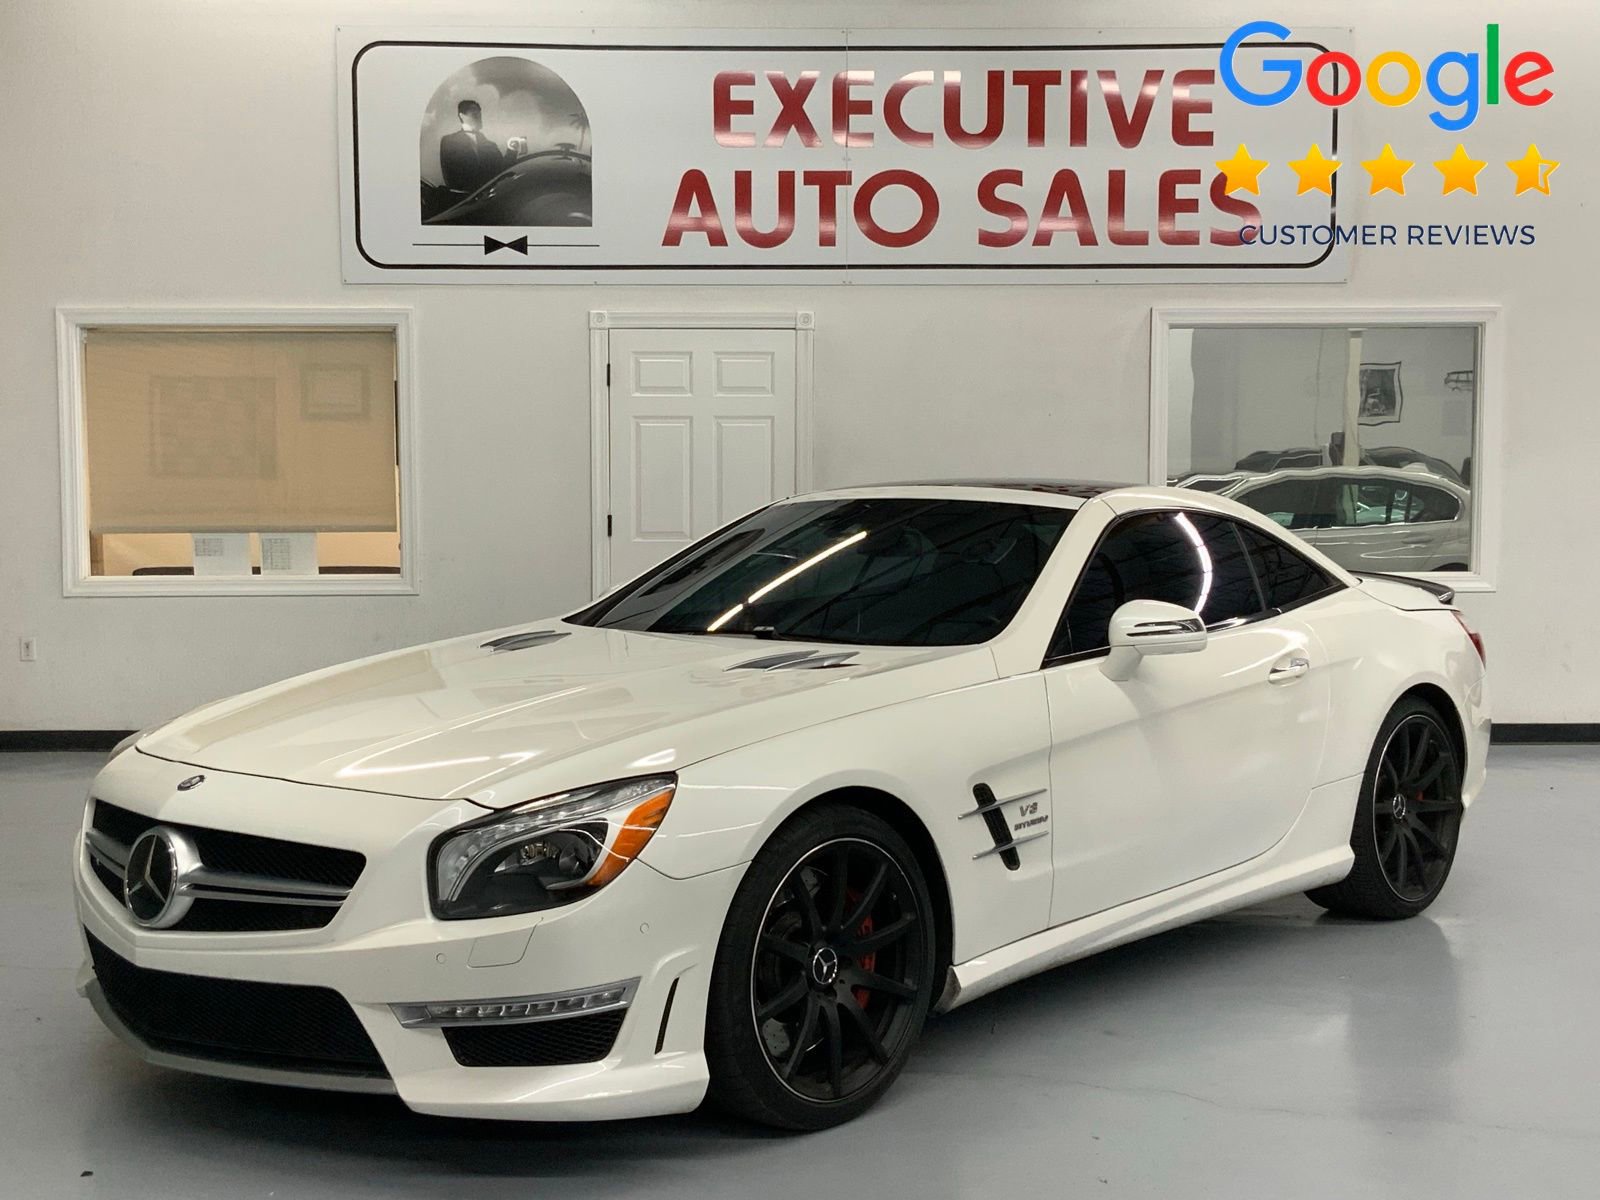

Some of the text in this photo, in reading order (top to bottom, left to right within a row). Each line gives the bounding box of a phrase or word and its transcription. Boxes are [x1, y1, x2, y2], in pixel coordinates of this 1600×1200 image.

[713, 69, 1215, 148] EXECUTIVE
[661, 167, 1263, 248] AUTO SALES
